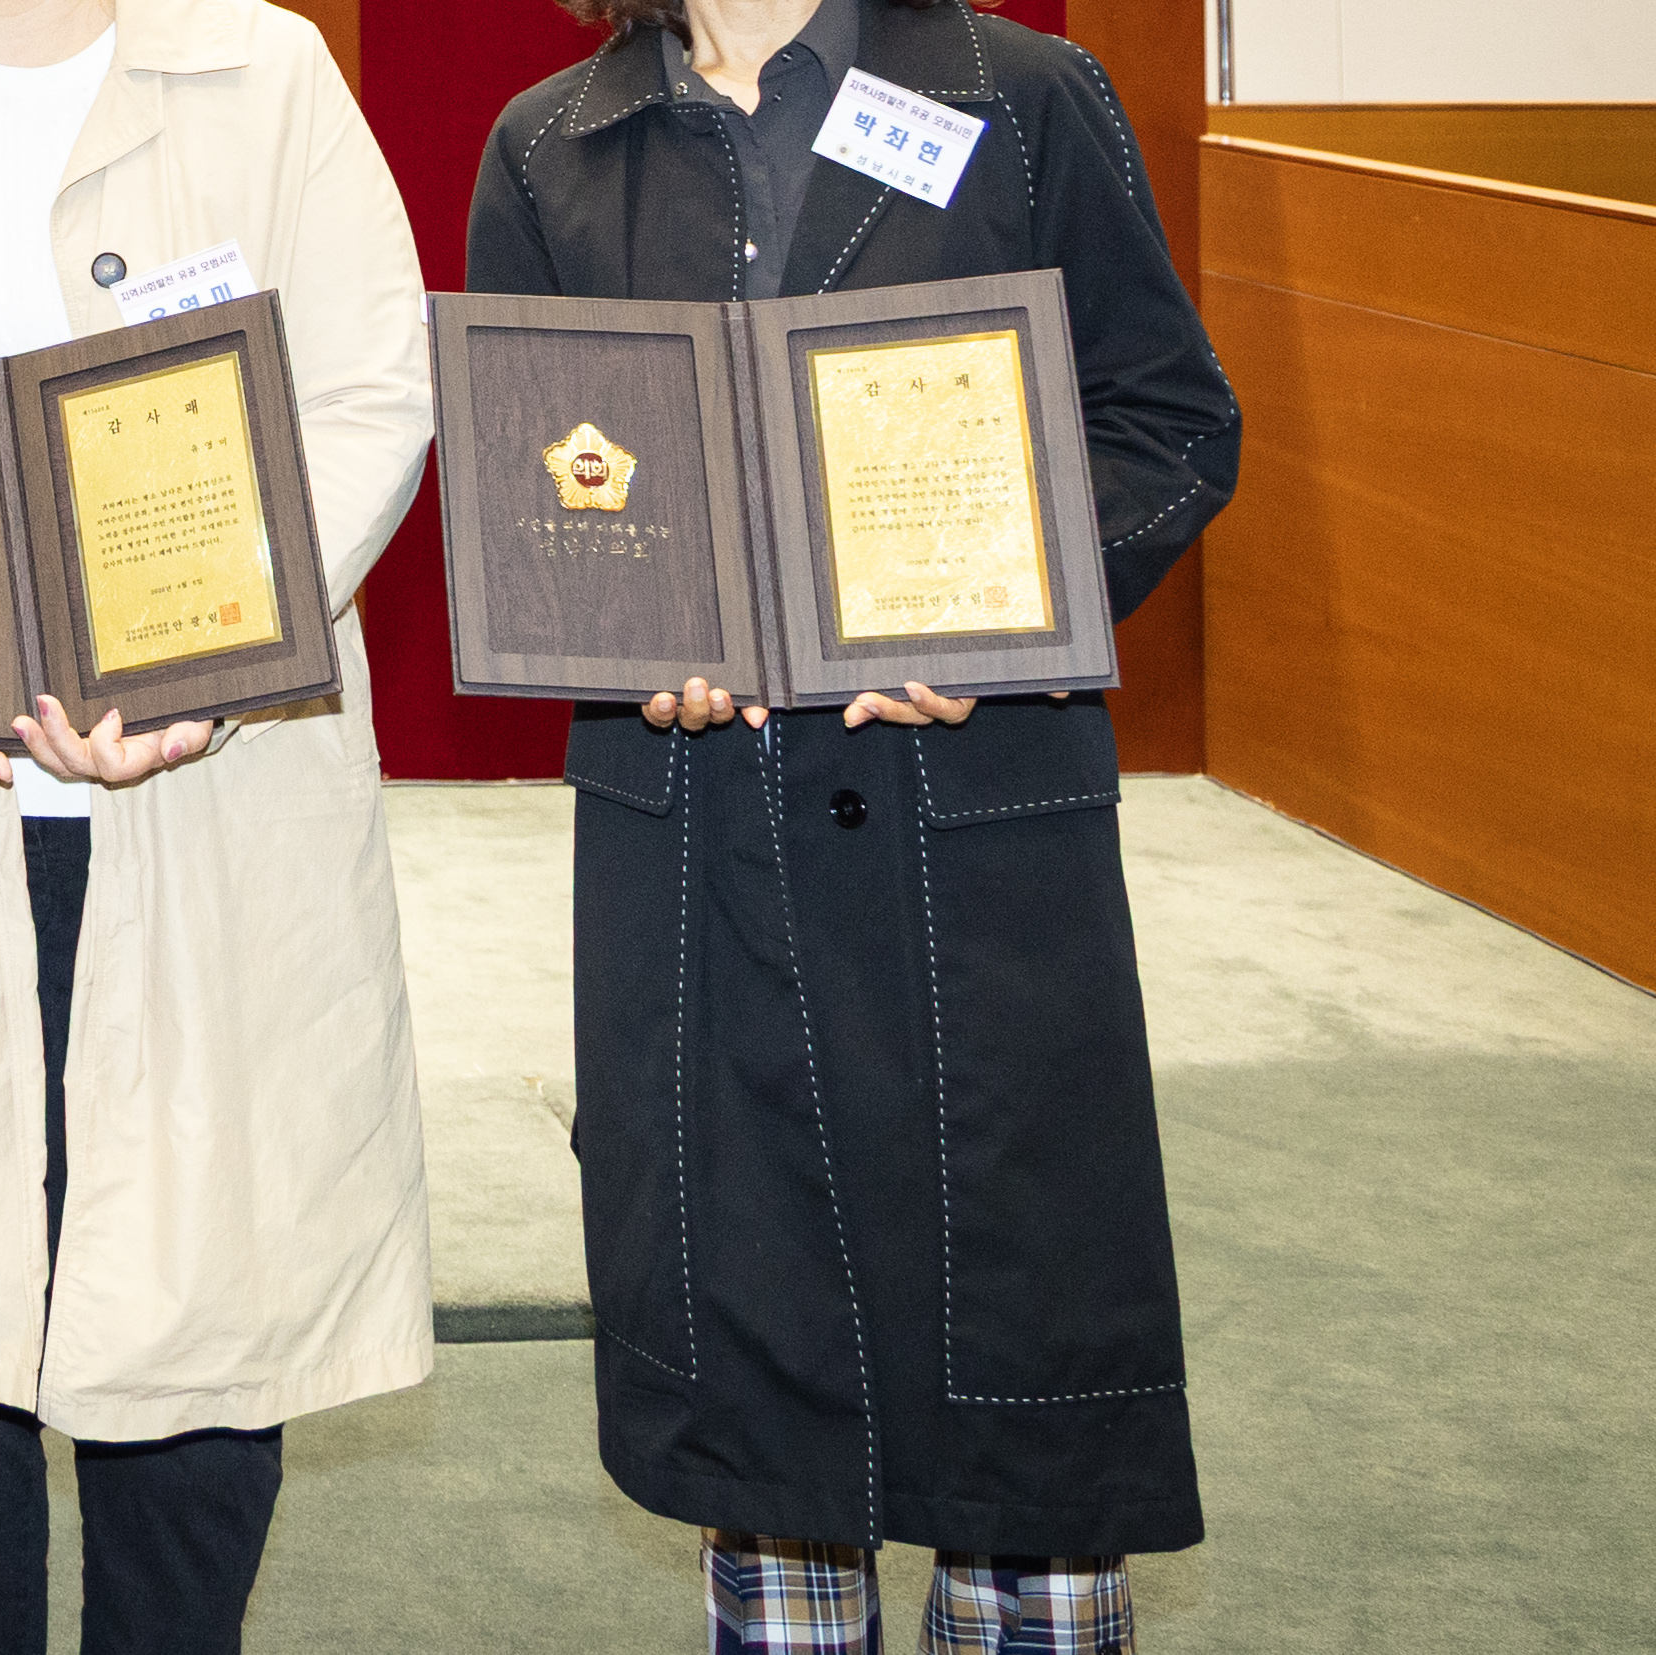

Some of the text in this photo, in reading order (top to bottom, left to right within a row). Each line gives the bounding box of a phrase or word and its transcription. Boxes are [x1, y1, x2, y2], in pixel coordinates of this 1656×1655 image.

[848, 79, 973, 140] 지역사회발전 유공 모범시민
[120, 250, 238, 303] 지역사회발전 유공 모범시민
